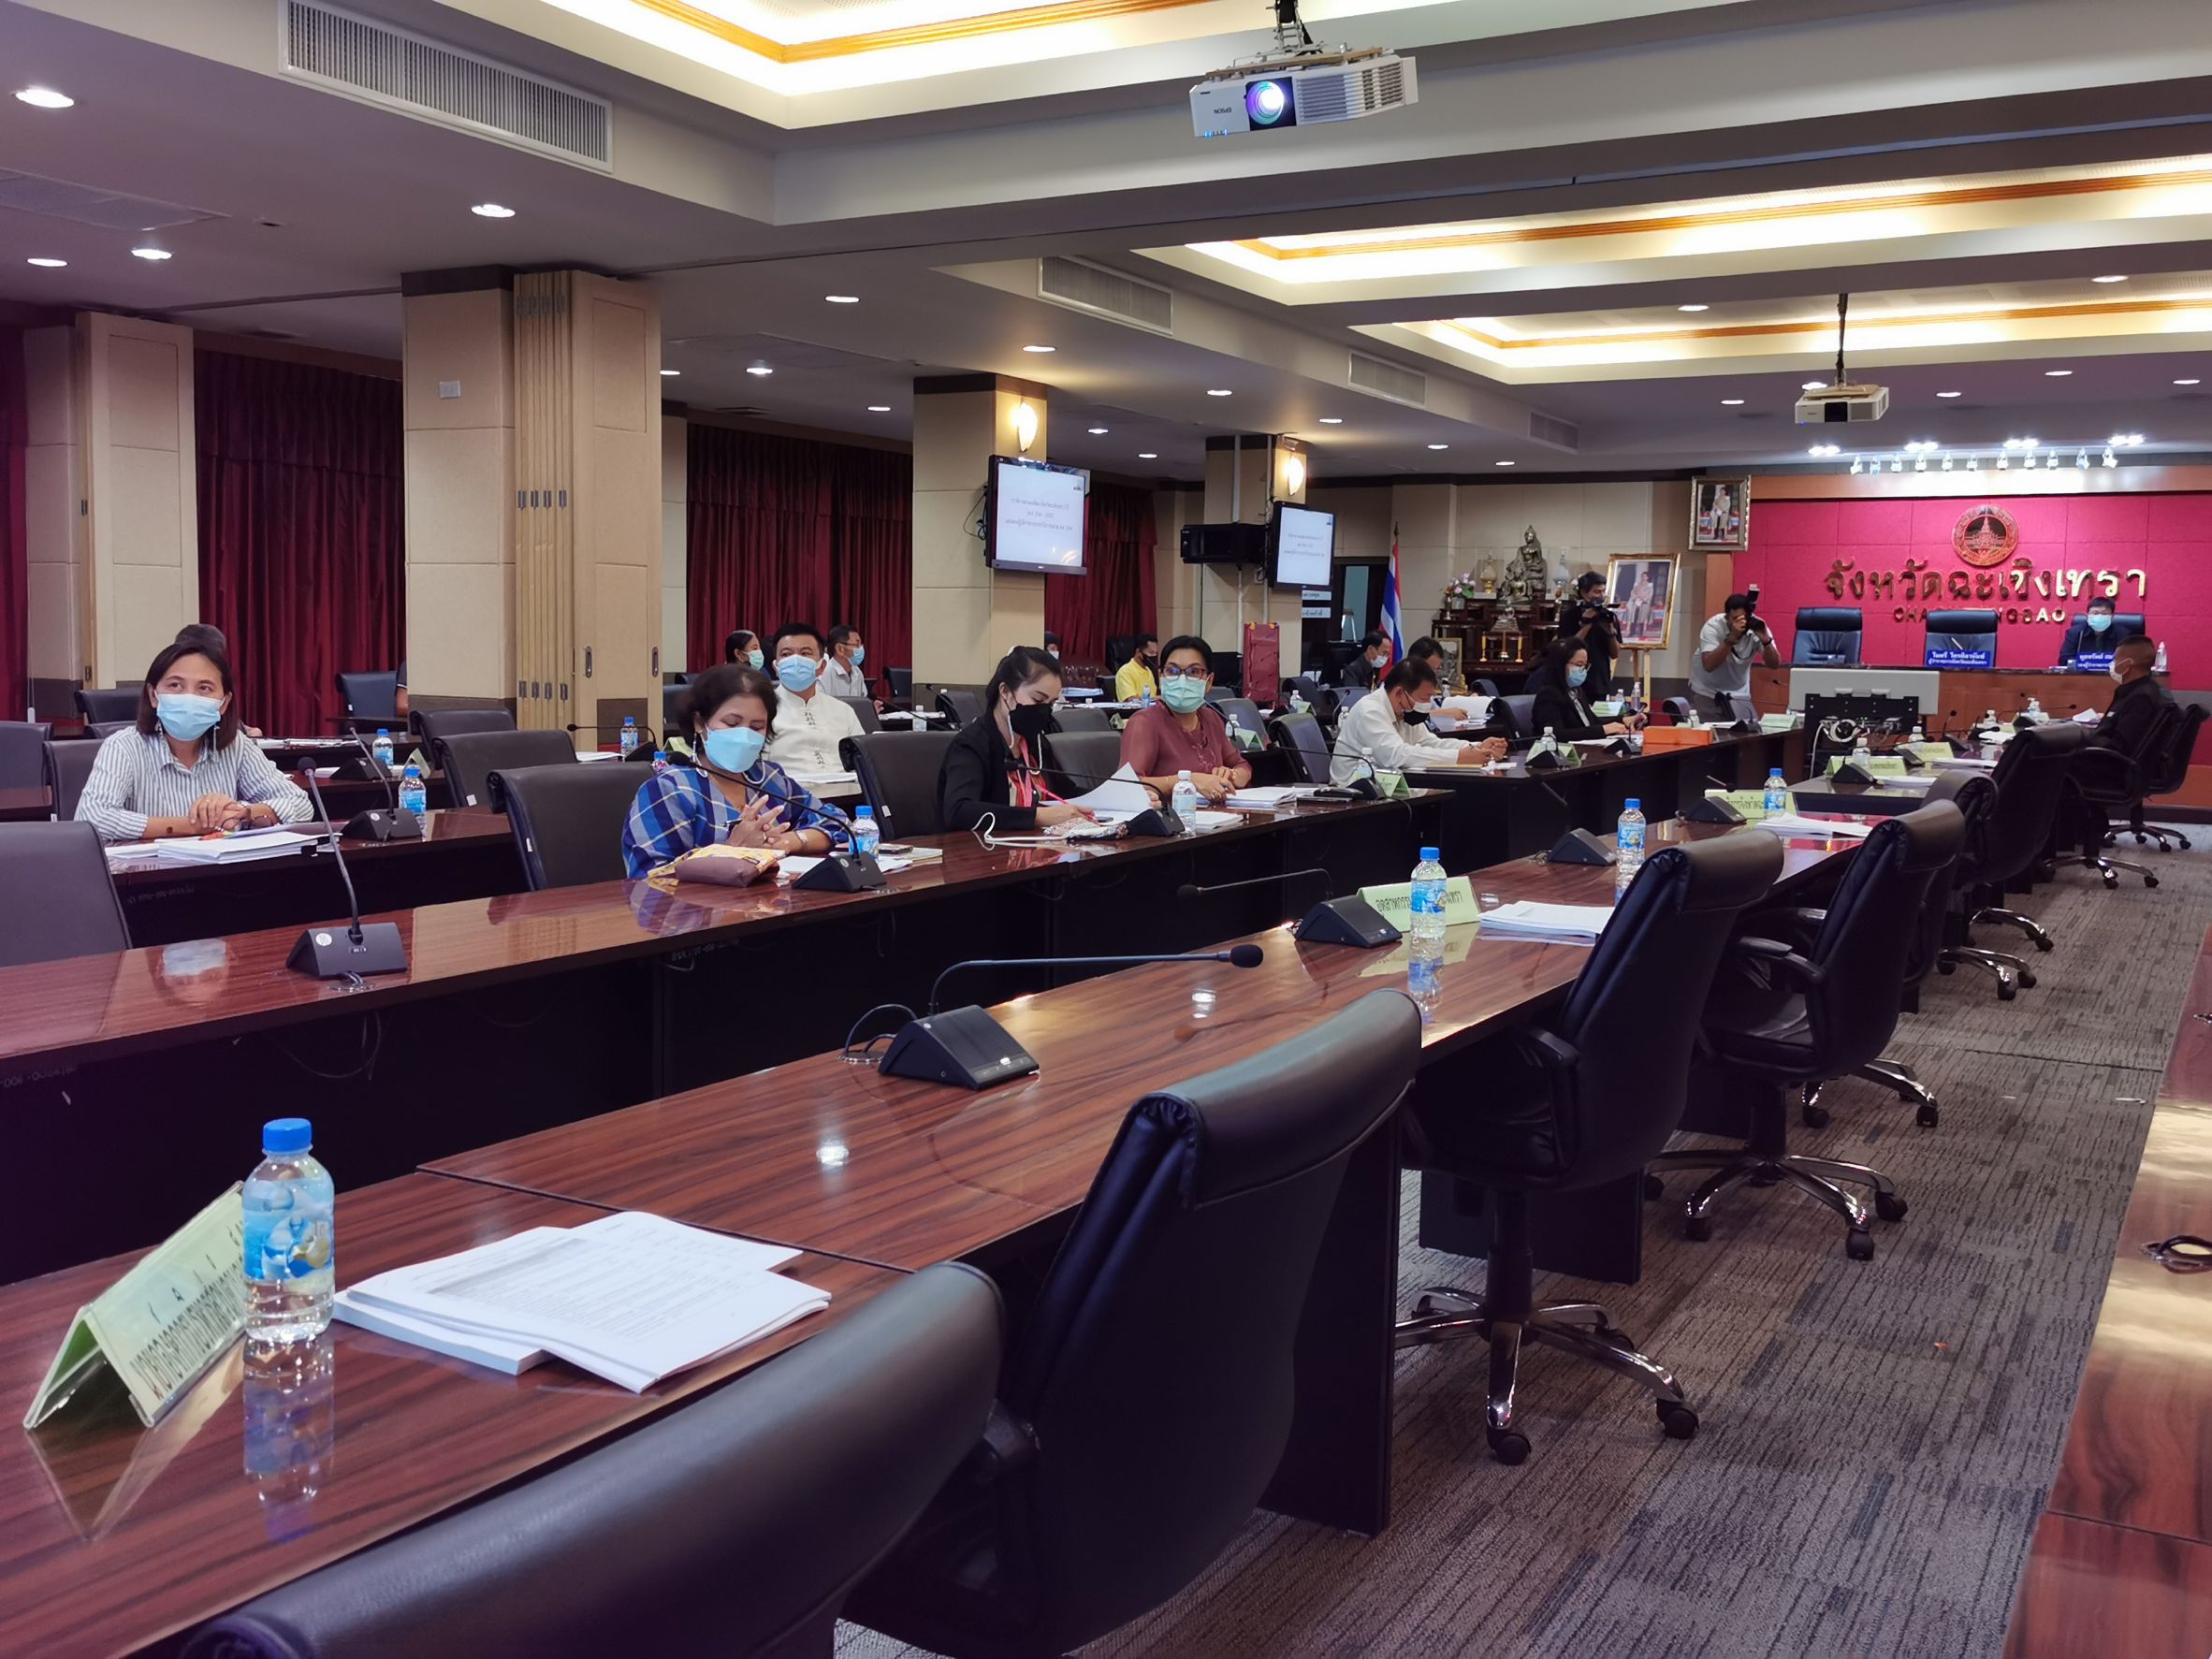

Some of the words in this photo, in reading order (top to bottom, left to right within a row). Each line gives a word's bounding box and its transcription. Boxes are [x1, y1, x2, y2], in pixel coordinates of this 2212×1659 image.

[1826, 559, 2146, 600] จังหวัดฉะเชิงเทรา
